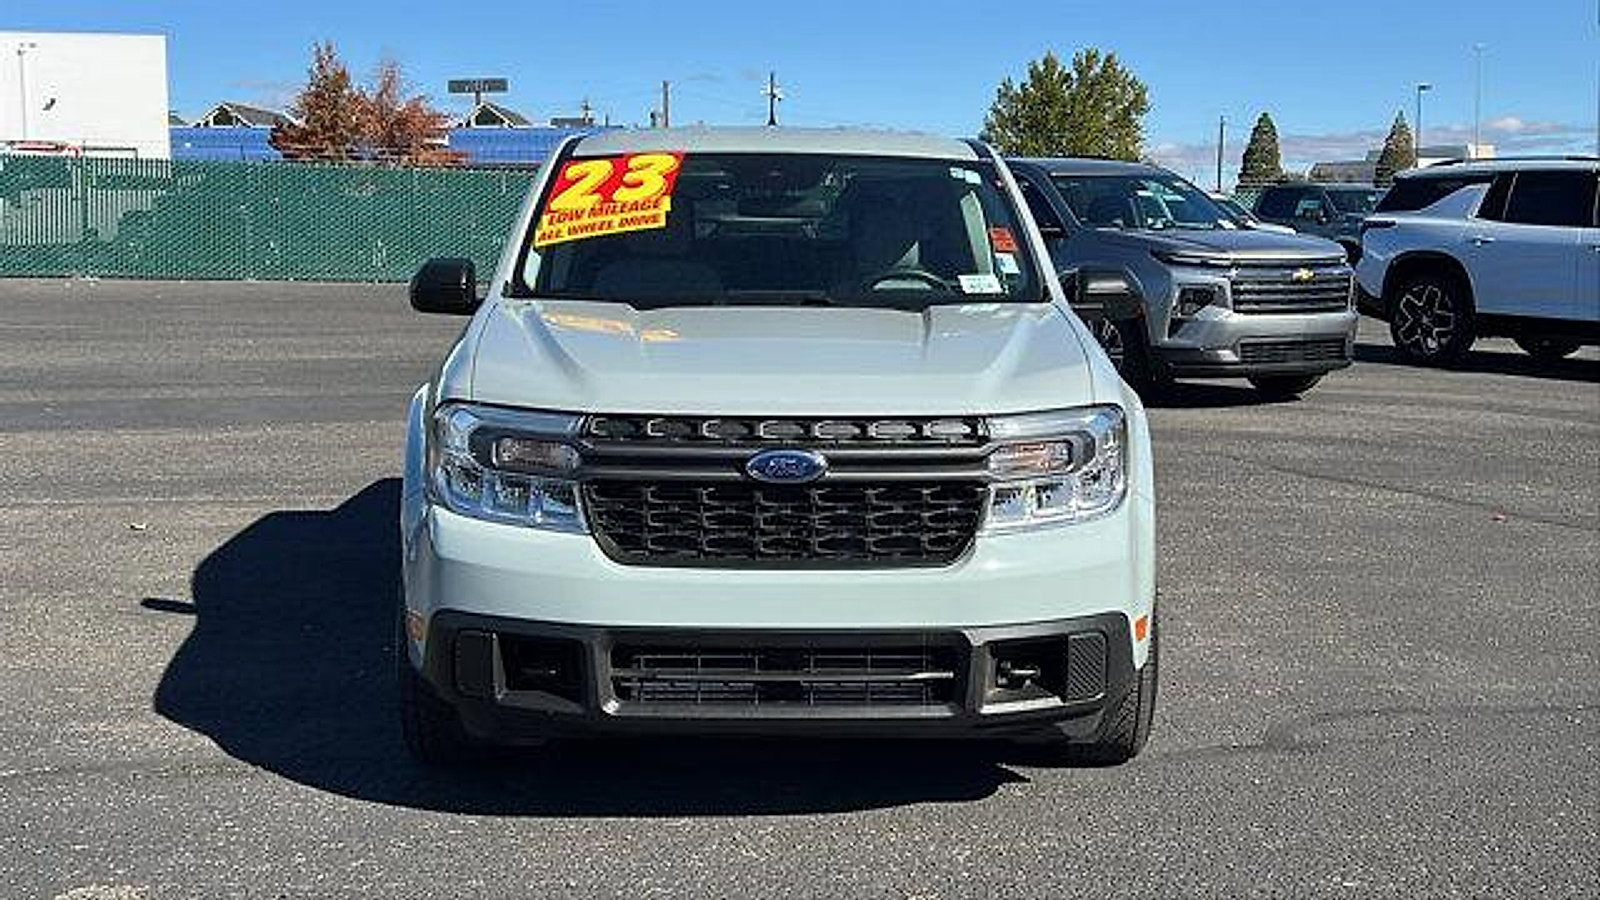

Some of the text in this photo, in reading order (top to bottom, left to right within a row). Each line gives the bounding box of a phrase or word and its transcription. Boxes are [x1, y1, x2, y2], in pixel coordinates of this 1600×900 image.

[550, 154, 678, 210] 23
[548, 199, 660, 224] LOW MILEAGE
[537, 213, 660, 242] ALL WHEEL DRIVE
